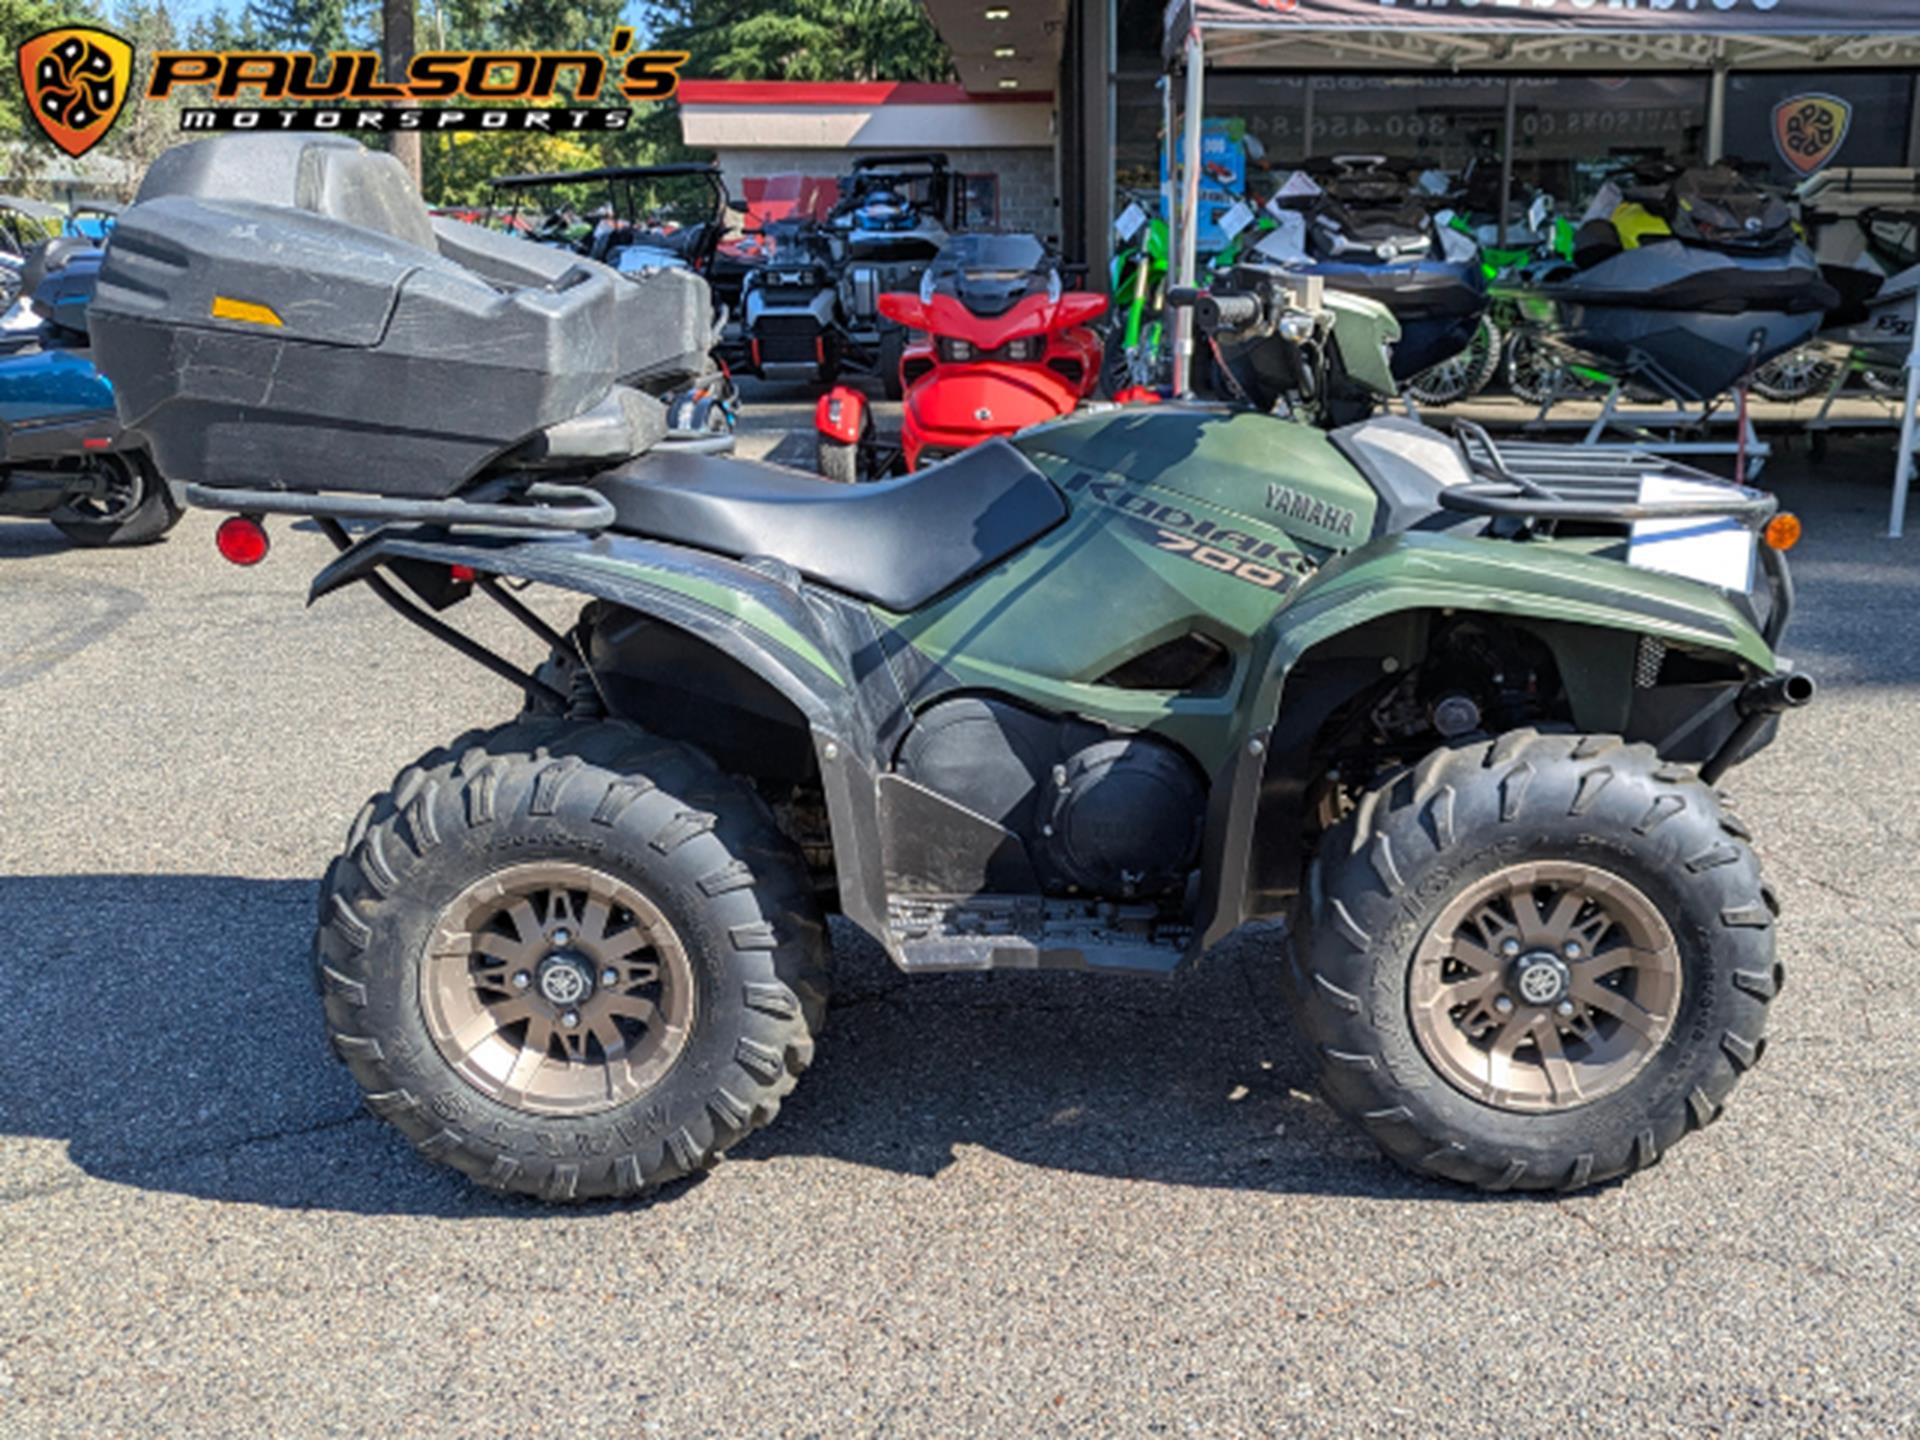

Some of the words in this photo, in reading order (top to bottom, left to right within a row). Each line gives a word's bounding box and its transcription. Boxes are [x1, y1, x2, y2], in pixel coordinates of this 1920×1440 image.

[1063, 470, 1318, 572] KODIAK
[1263, 481, 1354, 538] YAMAHA
[1156, 529, 1284, 589] 700
